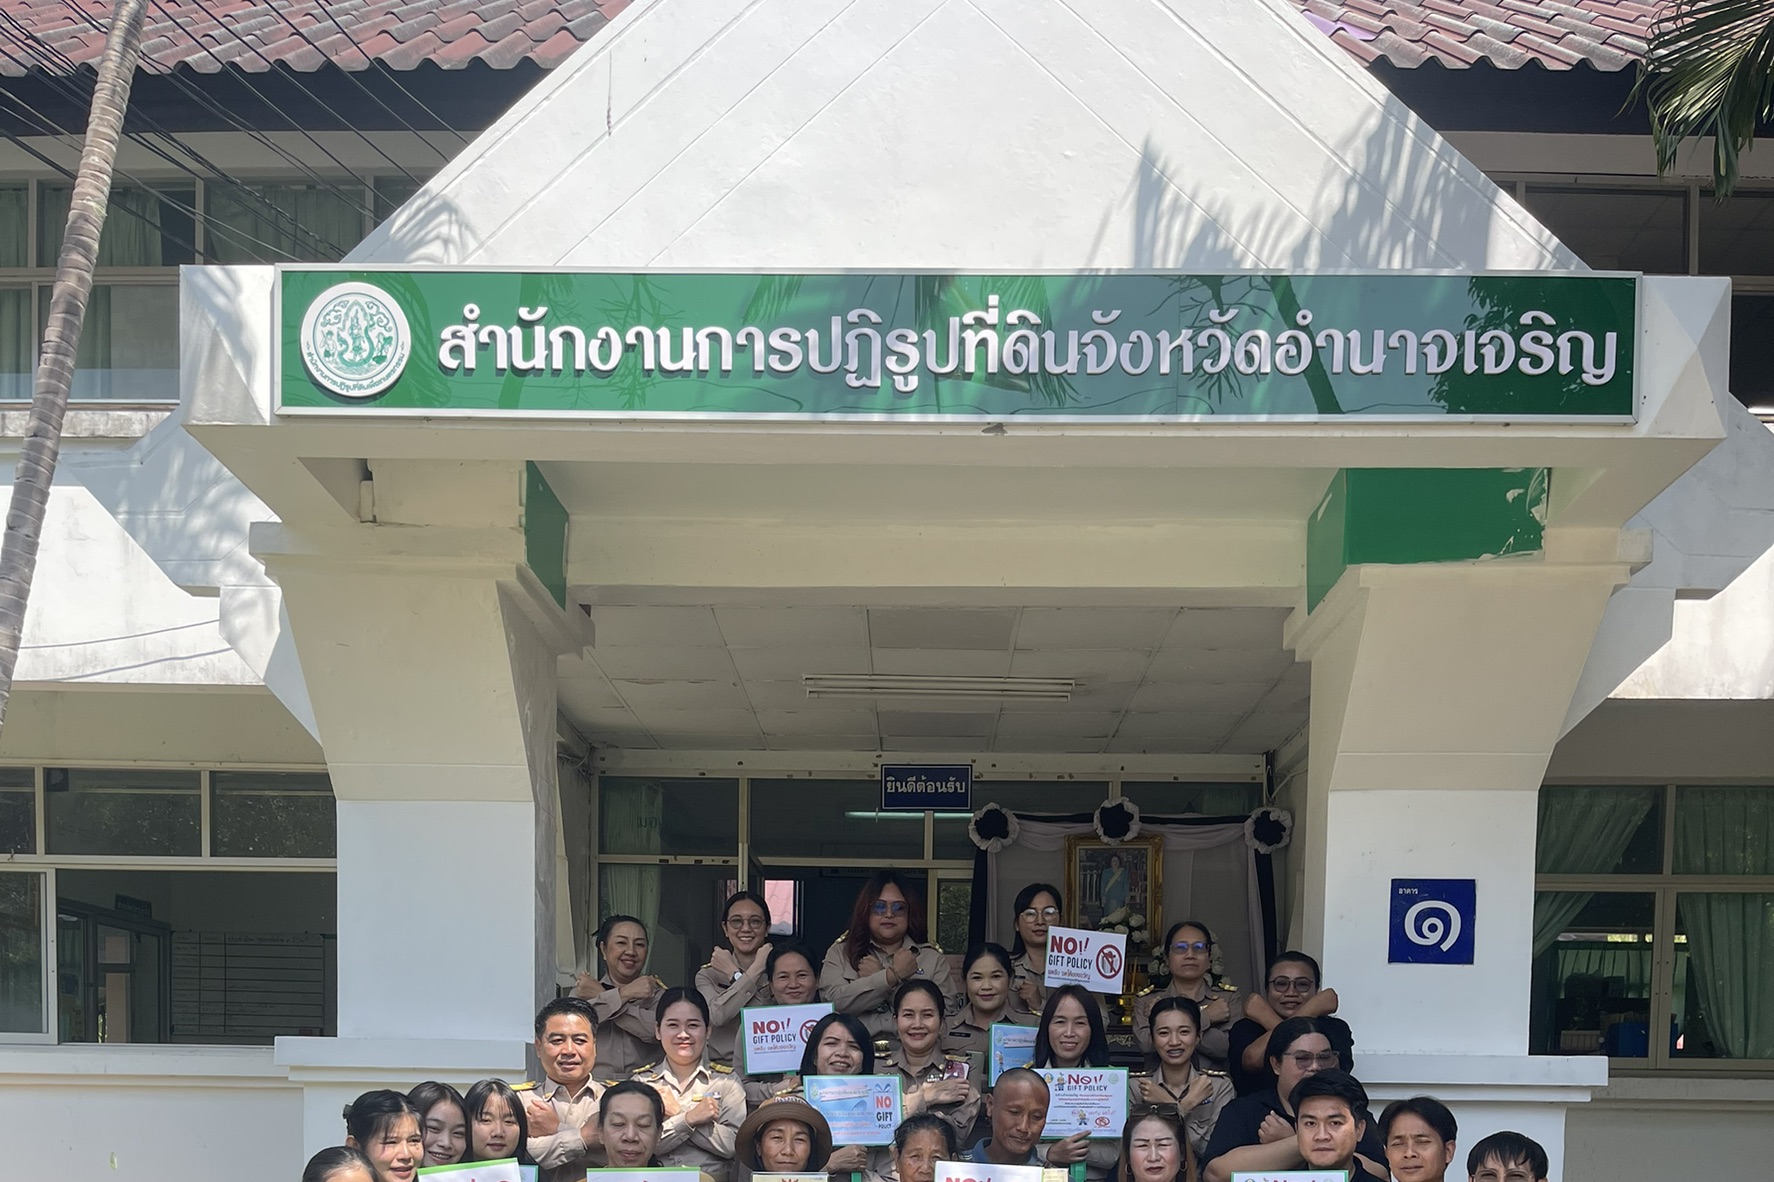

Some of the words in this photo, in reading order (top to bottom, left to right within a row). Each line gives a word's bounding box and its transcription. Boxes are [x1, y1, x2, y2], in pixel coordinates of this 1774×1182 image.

[438, 294, 1618, 391] สำนักงานการปฏิรูปที่ดินจังหวัดอำนาจเจริญ
[886, 775, 966, 793] ยินดีต้อนรับ
[1404, 900, 1461, 952] ๑
[1048, 954, 1065, 967] GIFT
[1066, 957, 1094, 970] POLICY
[753, 1035, 768, 1044] GIFT
[771, 1033, 796, 1043] POLICY
[876, 1096, 892, 1109] NO
[876, 1111, 893, 1121] GIFT
